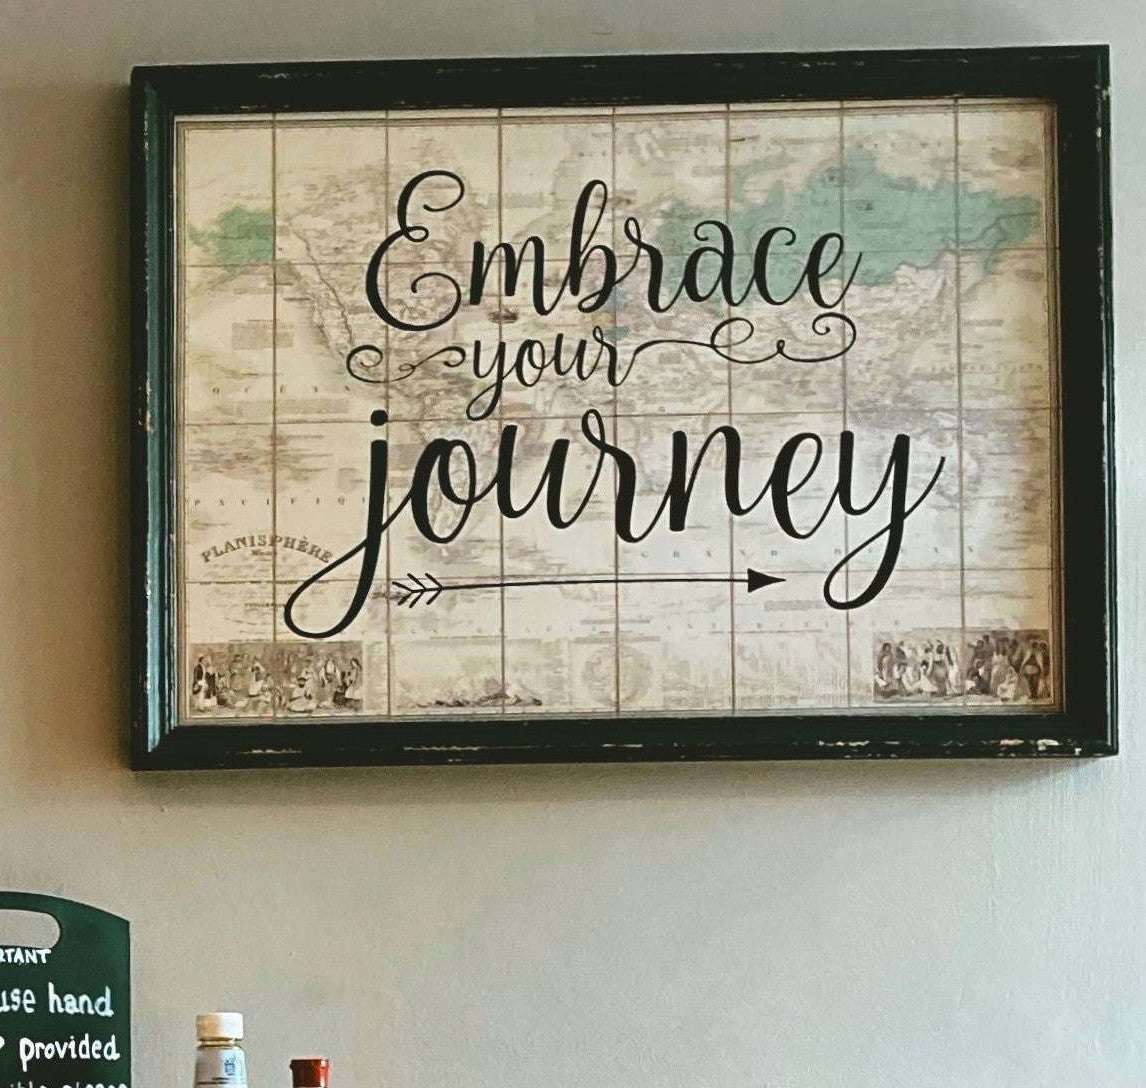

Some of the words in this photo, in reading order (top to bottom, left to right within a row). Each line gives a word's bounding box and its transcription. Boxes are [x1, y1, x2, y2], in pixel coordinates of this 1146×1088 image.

[365, 170, 863, 331] Embrace
[284, 410, 945, 638] journey
[201, 534, 333, 563] PLANISPHÈRE
[48, 981, 114, 1017] hand
[19, 1033, 120, 1072] provided
